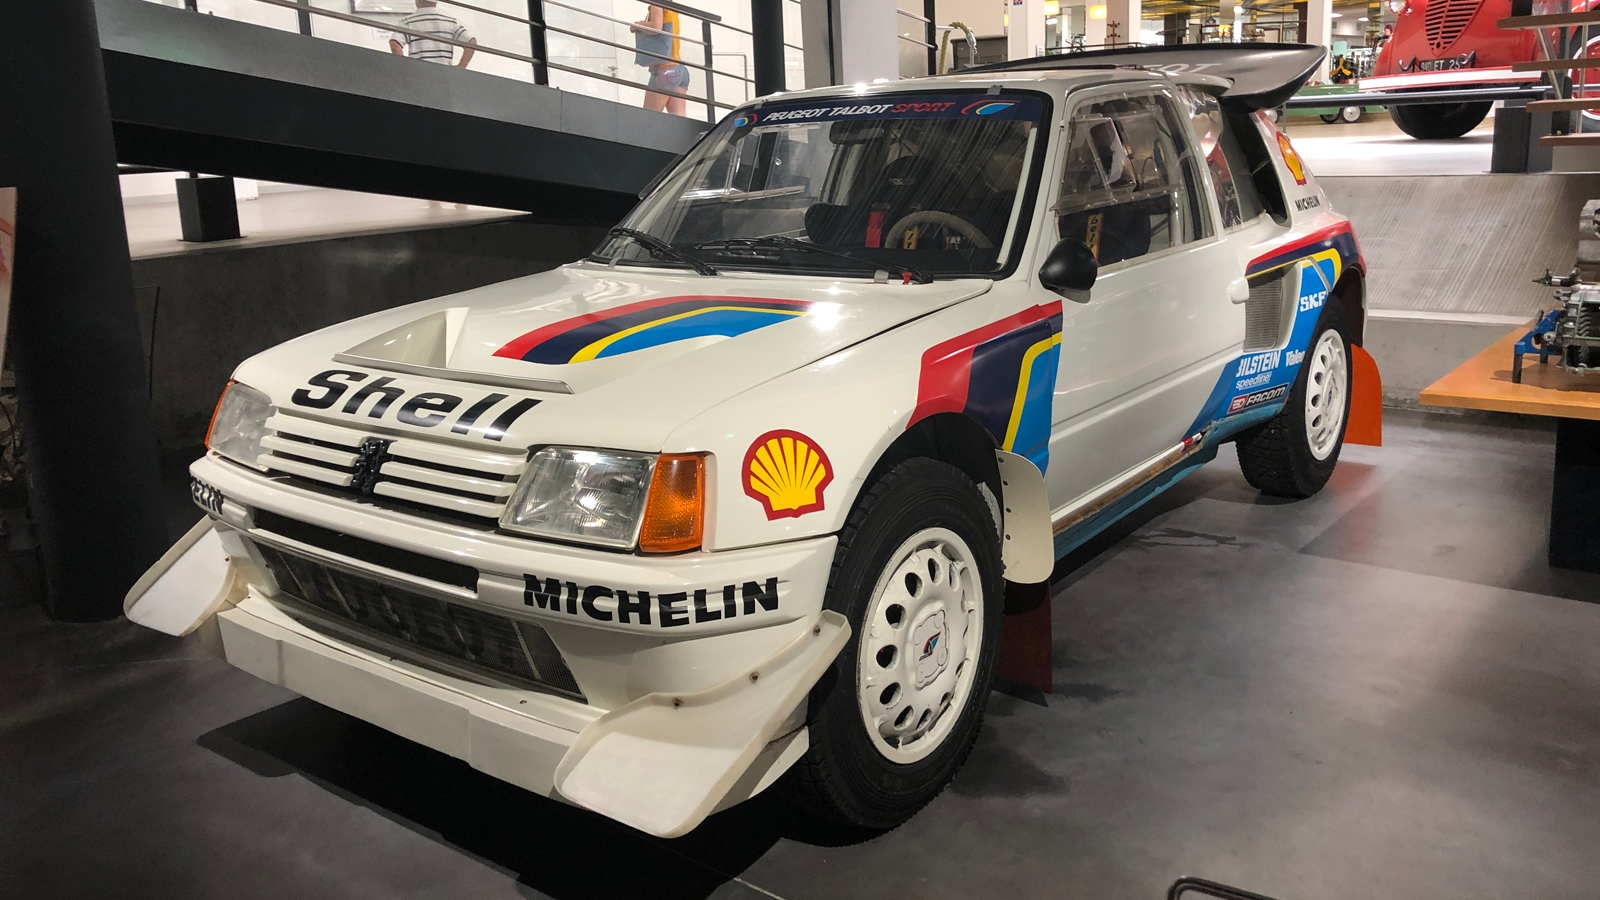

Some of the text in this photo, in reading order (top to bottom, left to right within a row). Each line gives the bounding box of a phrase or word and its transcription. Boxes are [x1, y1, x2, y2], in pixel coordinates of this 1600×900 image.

[1434, 60, 1445, 72] ET
[762, 102, 956, 121] PEUGEOT TALBOT SPORT
[1294, 195, 1320, 212] MICHELIN
[1300, 290, 1327, 312] SKF
[1236, 371, 1272, 391] speedline
[291, 369, 543, 442] Shell
[1246, 386, 1286, 406] FACOM
[190, 476, 224, 515] ELIN
[523, 573, 779, 628] MICHELIN
